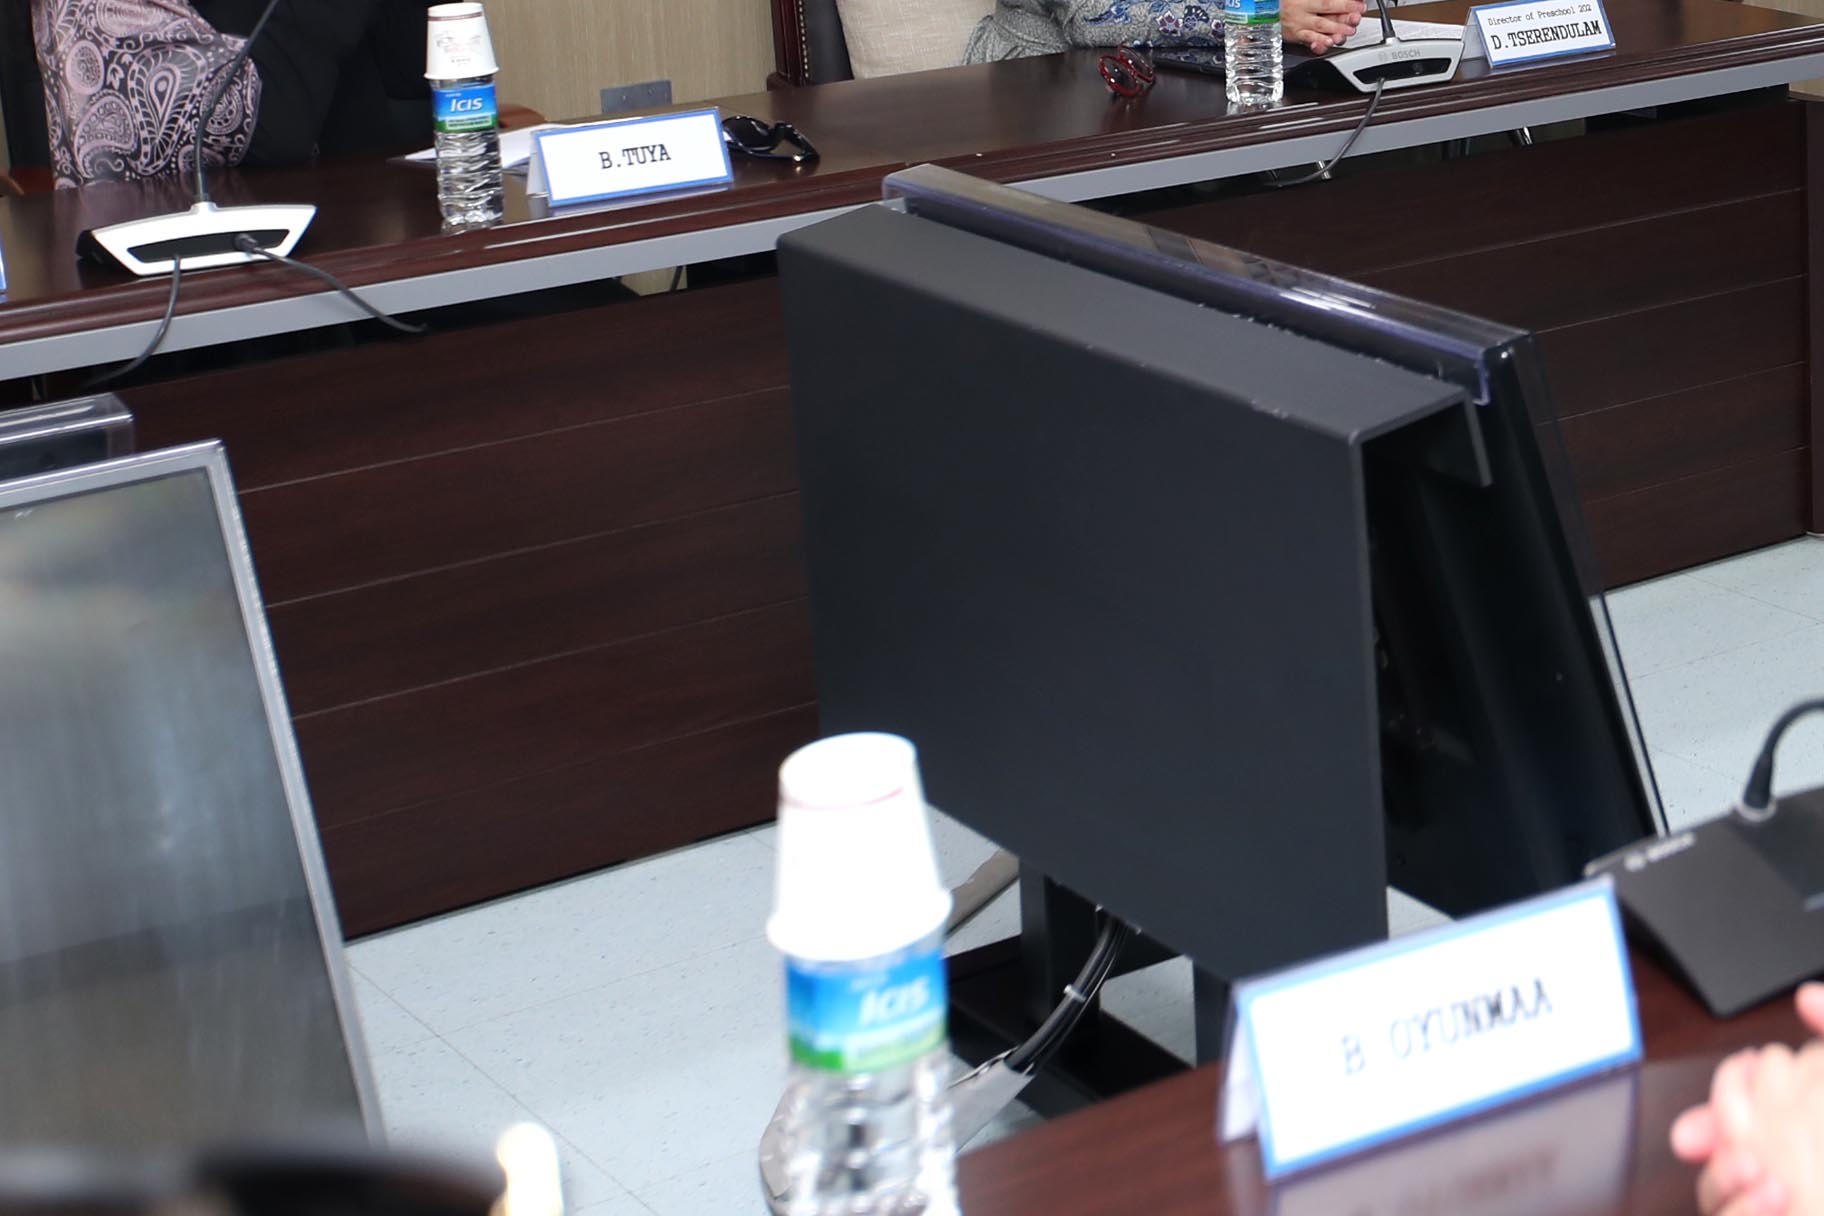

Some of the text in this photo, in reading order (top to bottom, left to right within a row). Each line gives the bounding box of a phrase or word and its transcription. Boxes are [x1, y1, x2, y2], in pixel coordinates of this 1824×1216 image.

[1487, 15, 1522, 27] Director
[1525, 12, 1535, 22] of
[1538, 5, 1576, 20] Preschool
[1490, 20, 1602, 50] D.TSERENDULAM
[1391, 48, 1421, 60] BOSCH
[598, 143, 672, 170] B.TUYA
[1389, 977, 1553, 1059] OYUNMAA
